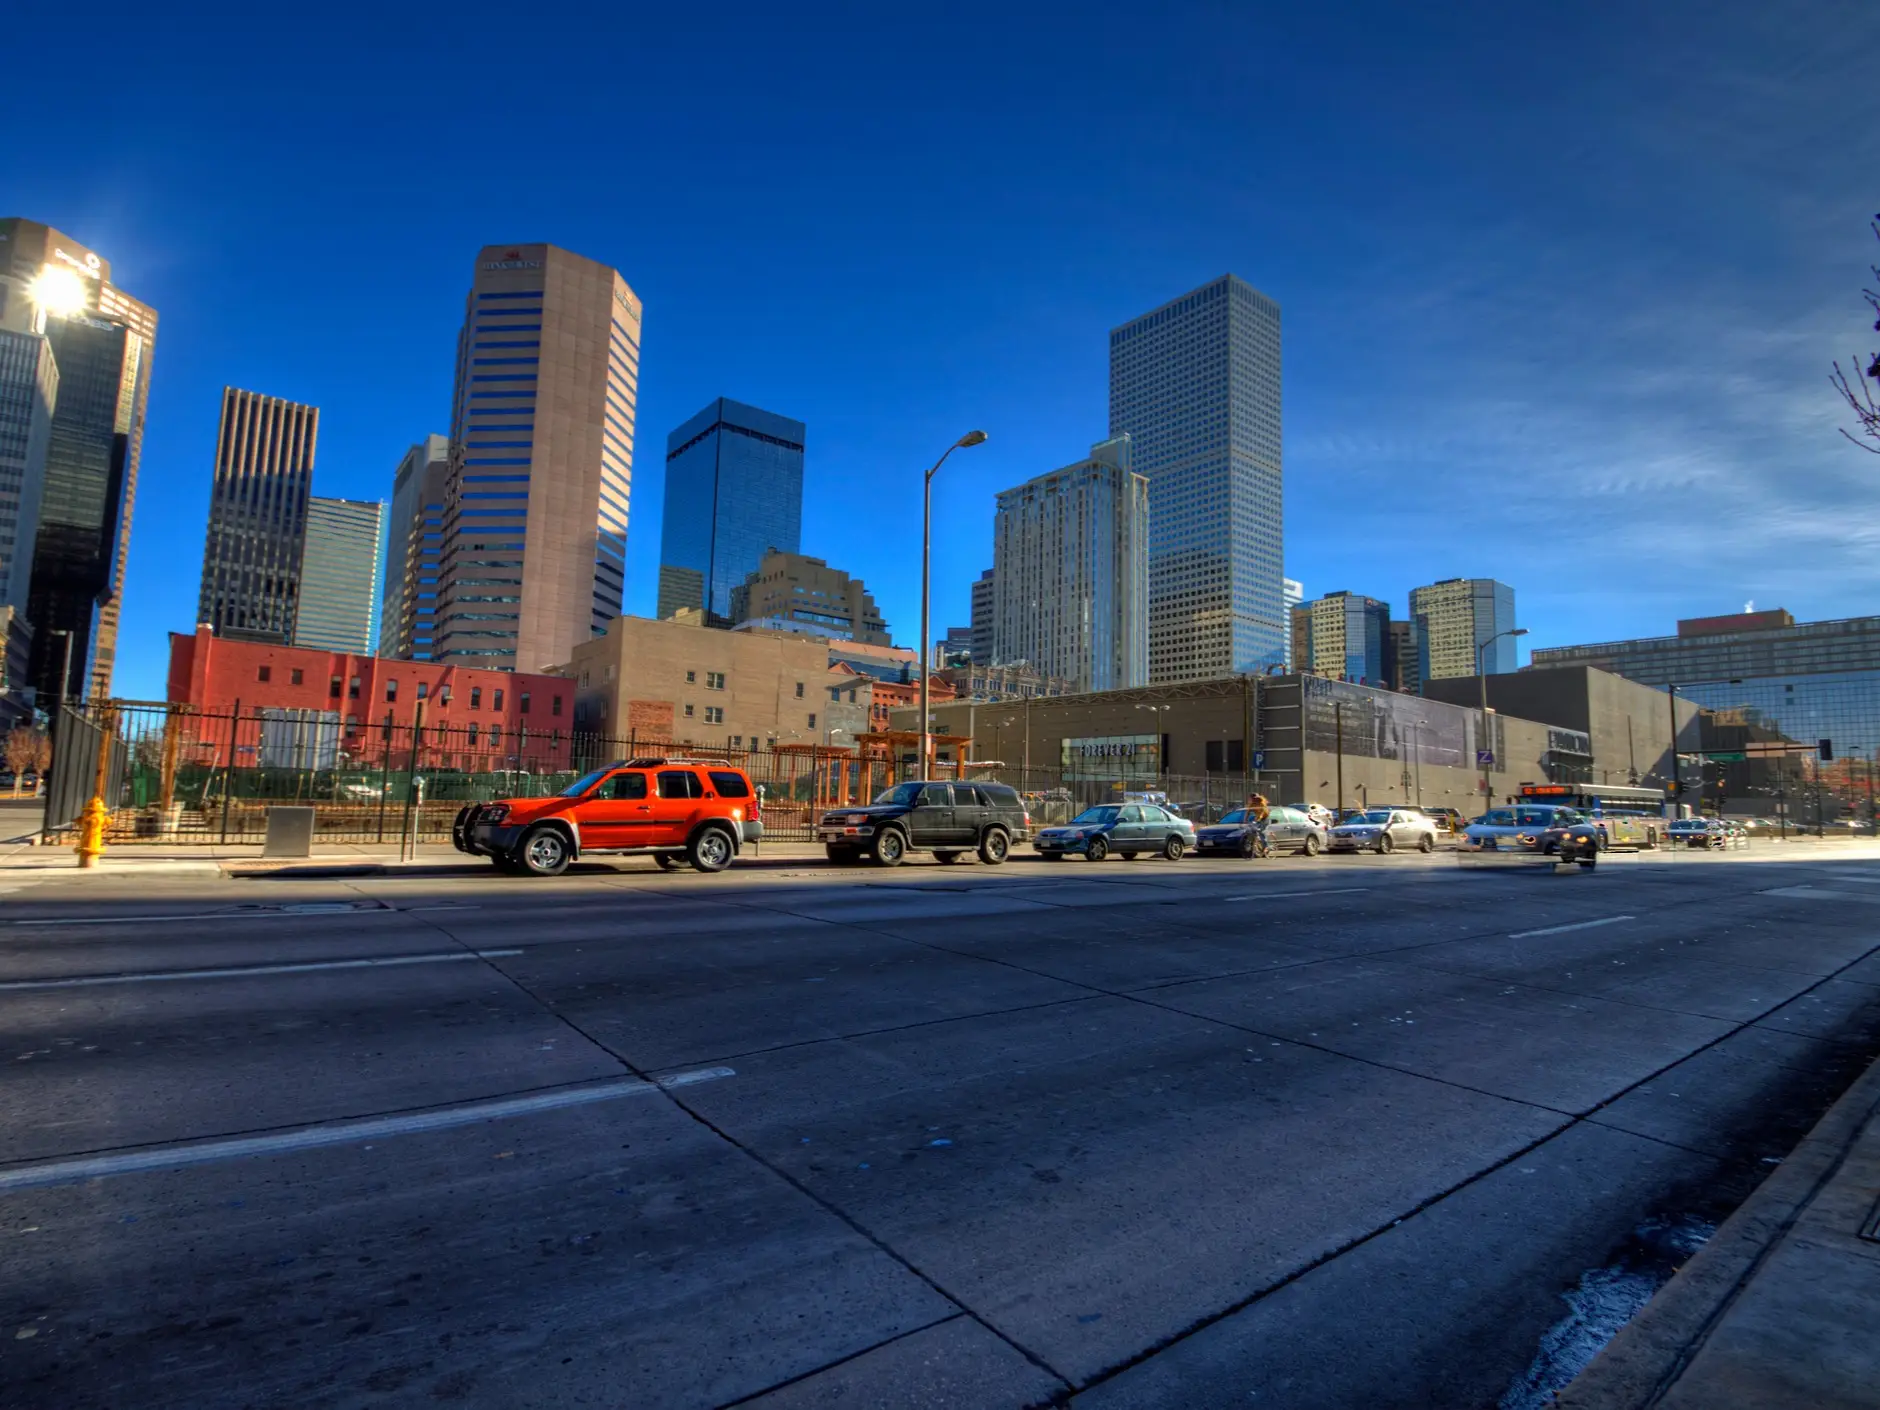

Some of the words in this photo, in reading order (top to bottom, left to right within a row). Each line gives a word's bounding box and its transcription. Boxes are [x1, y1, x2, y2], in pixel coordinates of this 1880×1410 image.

[1080, 743, 1122, 756] FOREVER
[1126, 743, 1135, 756] 21
[1480, 752, 1491, 763] Z
